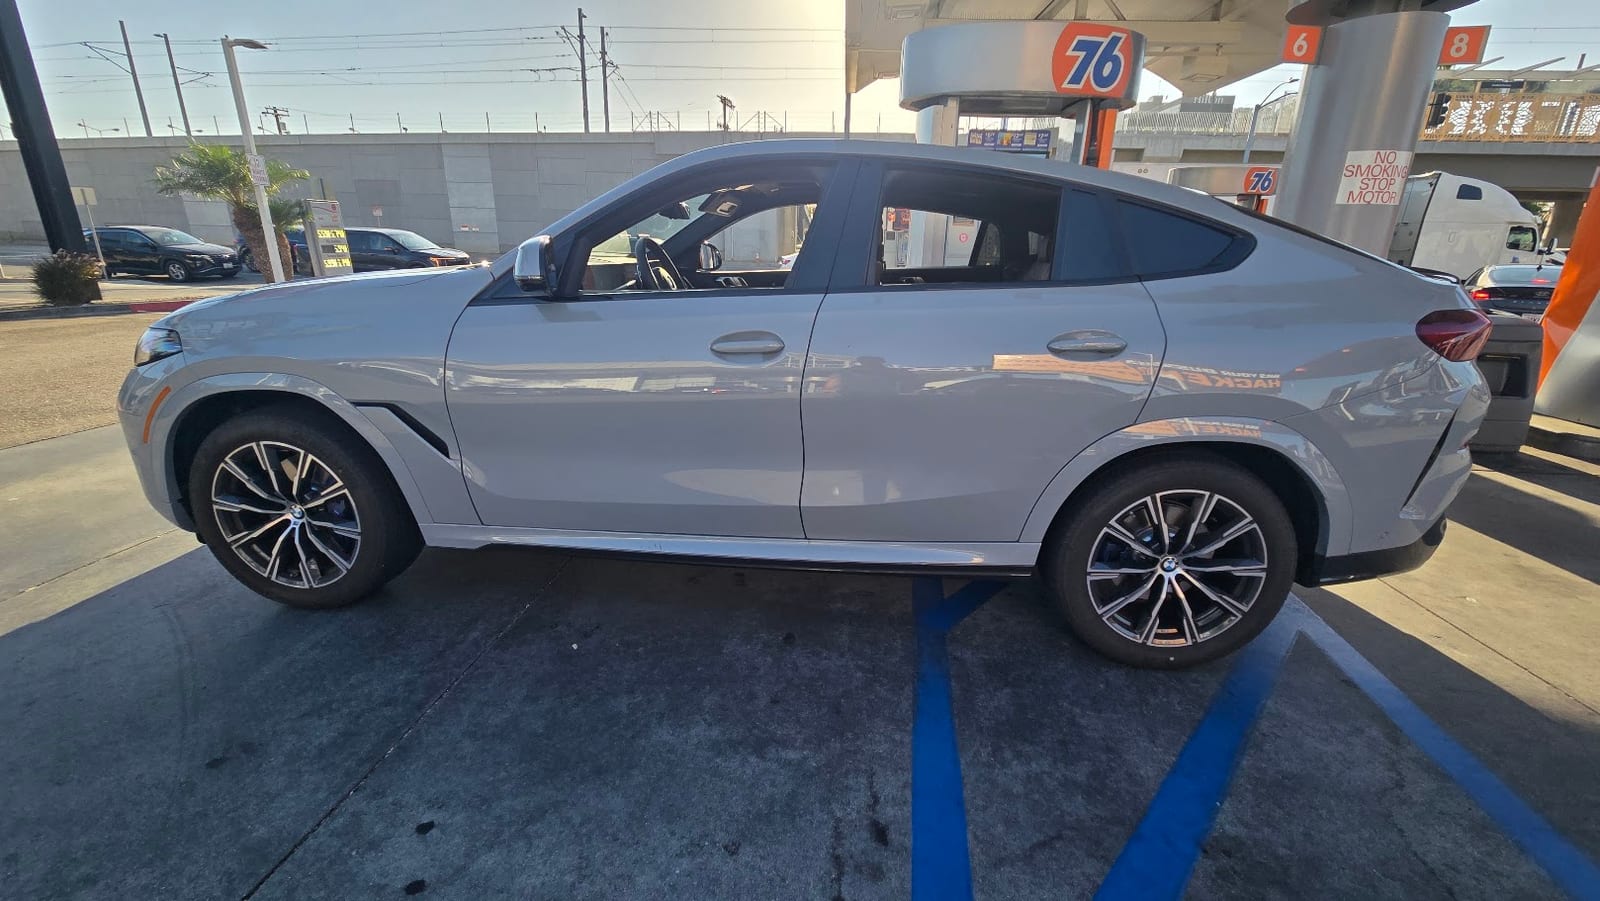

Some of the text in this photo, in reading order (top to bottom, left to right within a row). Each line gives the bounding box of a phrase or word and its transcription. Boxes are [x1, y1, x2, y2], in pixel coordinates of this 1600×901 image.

[1293, 33, 1308, 57] 6
[1450, 33, 1470, 58] 8
[1061, 31, 1128, 92] 76
[1374, 151, 1397, 165] NO
[1248, 169, 1275, 193] 76
[1343, 164, 1408, 179] SMOKING
[1359, 177, 1396, 191] STOP
[1346, 190, 1397, 204] MOTOR
